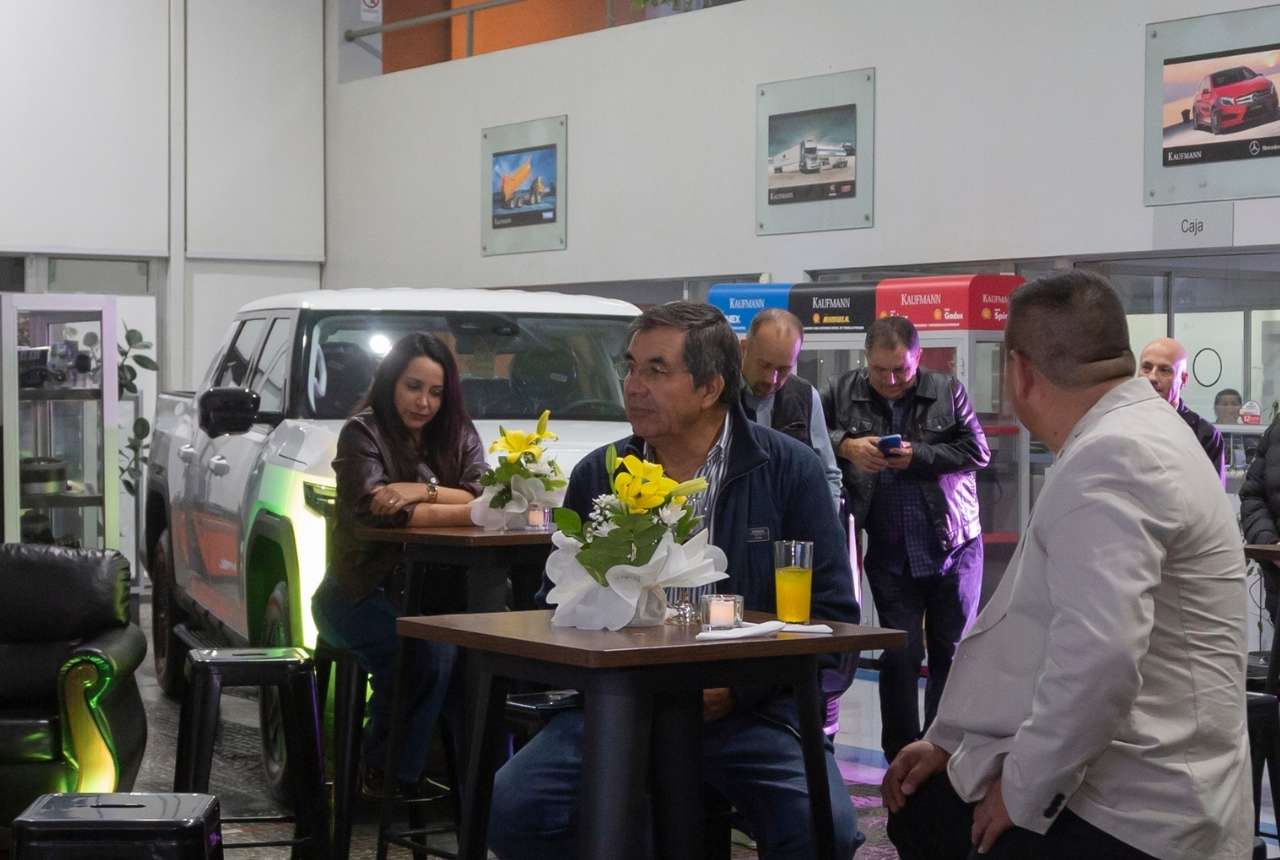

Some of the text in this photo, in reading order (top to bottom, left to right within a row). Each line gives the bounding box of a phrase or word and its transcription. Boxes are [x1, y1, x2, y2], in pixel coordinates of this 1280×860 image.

[1168, 151, 1202, 161] KAUFMANN
[1181, 218, 1204, 236] Caja
[729, 298, 766, 309] KAUFMANN
[812, 296, 851, 309] KAUFMANN
[901, 294, 942, 306] KAUFMANN
[994, 312, 1008, 322] Spir
